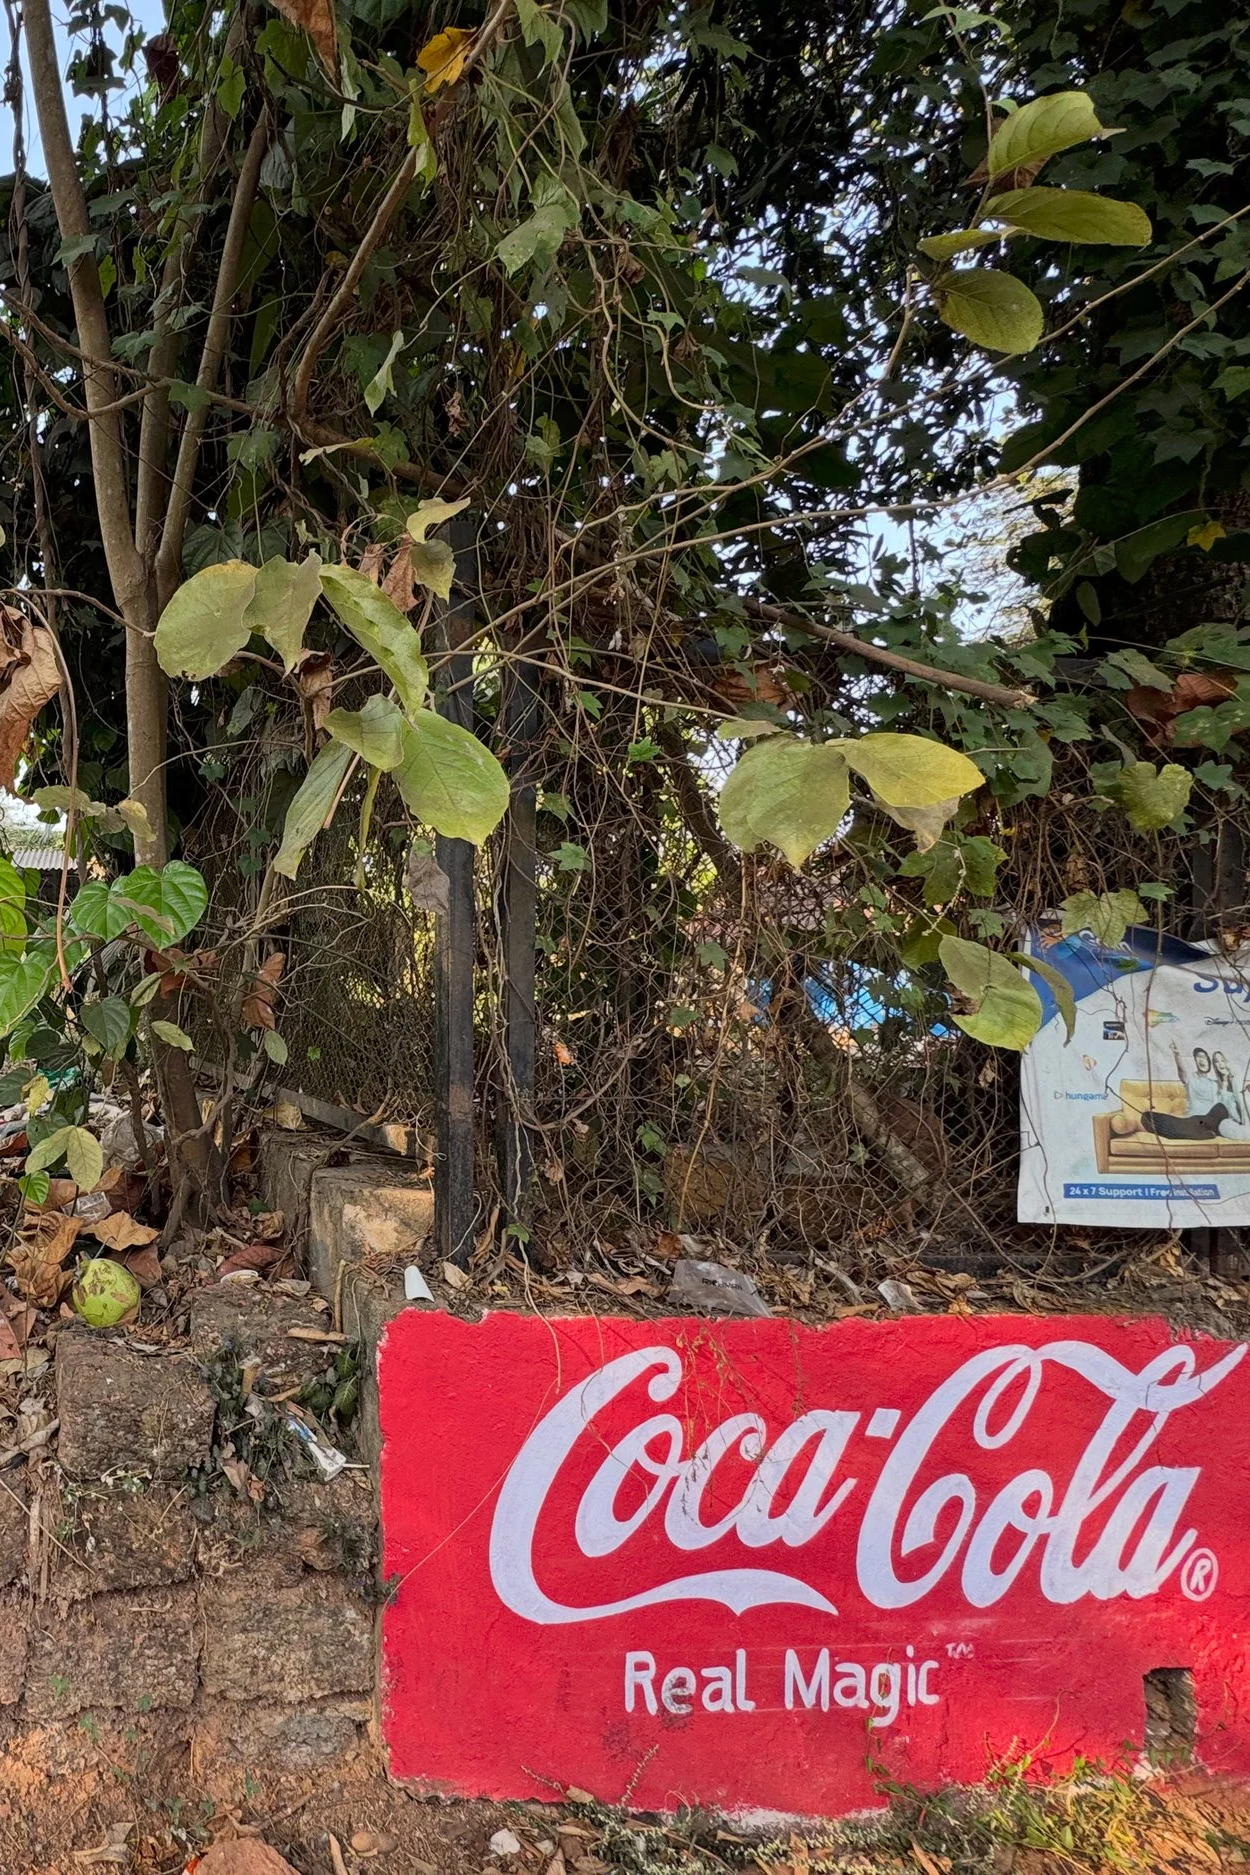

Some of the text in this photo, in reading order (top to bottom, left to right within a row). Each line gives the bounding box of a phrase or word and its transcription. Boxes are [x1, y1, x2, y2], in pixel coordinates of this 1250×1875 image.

[1069, 1187, 1080, 1195] 24
[1091, 1187, 1096, 1195] 7
[1099, 1187, 1143, 1197] Support
[489, 1342, 1248, 1625] Coca-Cola
[624, 1648, 756, 1714] Real
[784, 1645, 940, 1728] Magic
